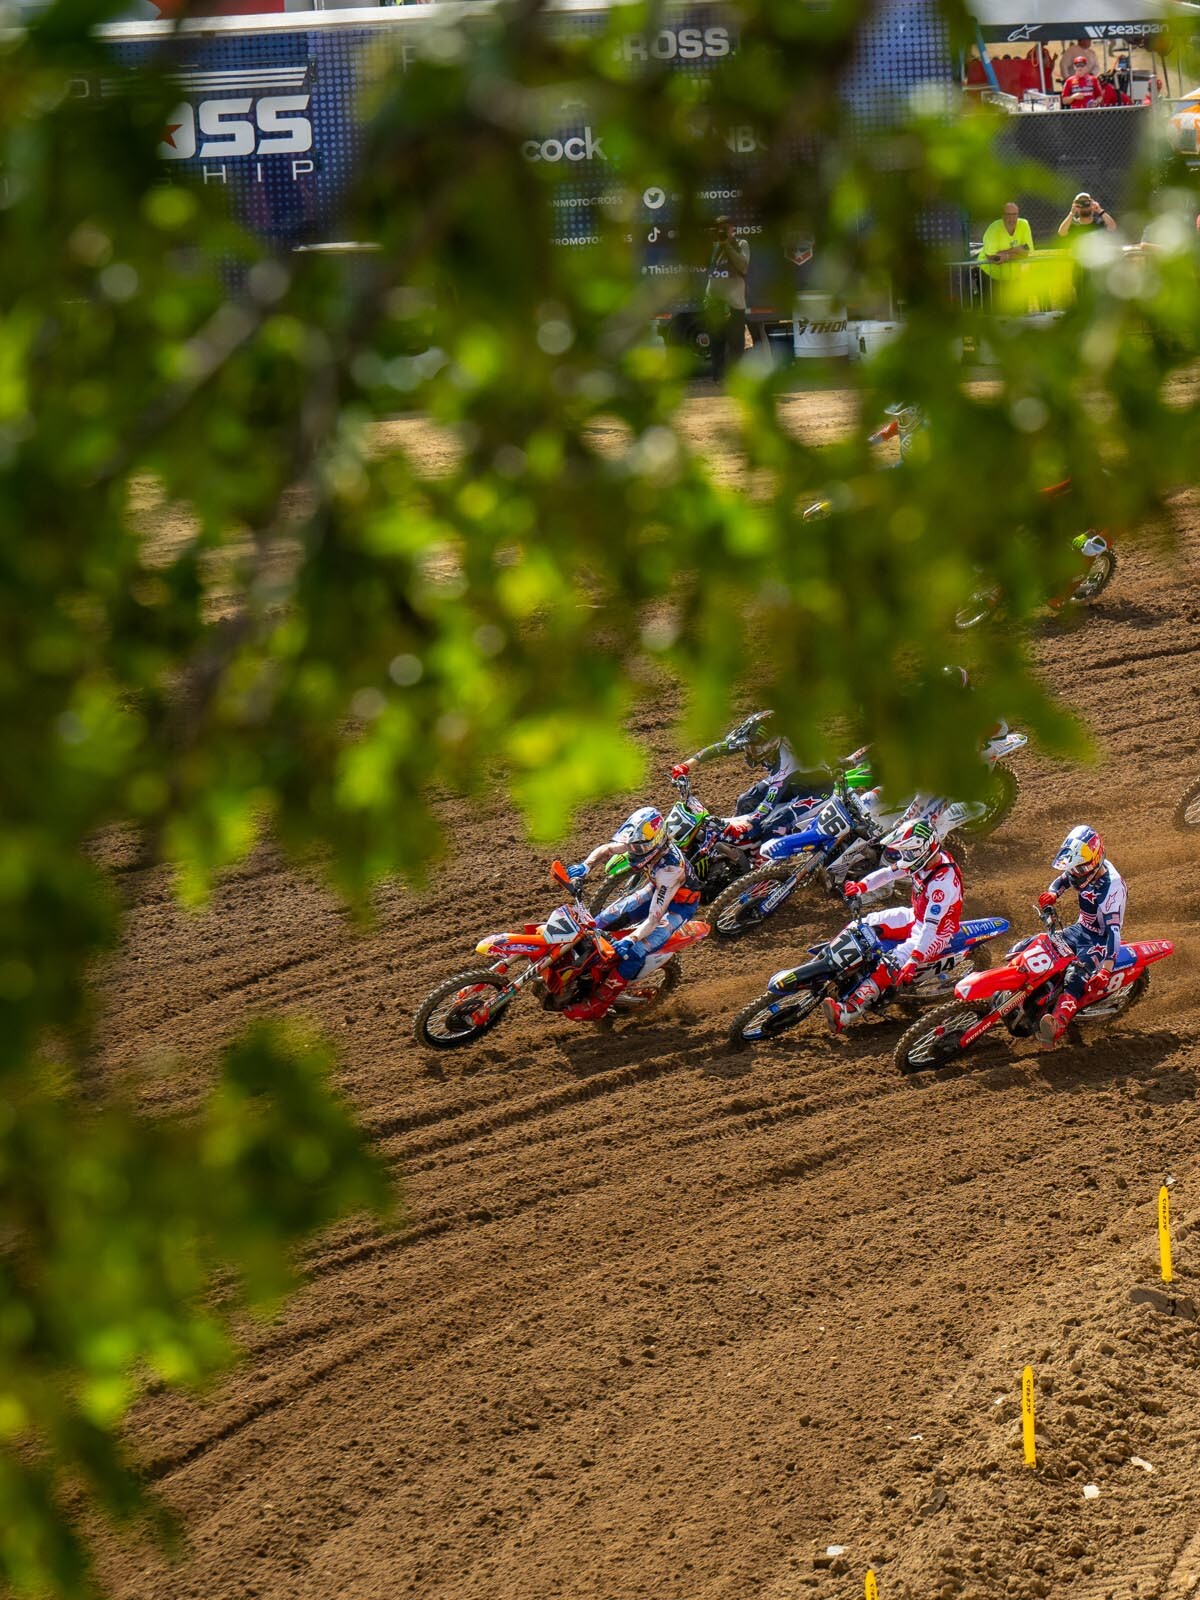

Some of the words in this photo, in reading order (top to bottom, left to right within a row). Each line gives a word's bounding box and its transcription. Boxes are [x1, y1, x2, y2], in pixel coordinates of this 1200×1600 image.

[819, 804, 847, 837] 36
[656, 885, 668, 906] THOR
[766, 884, 789, 908] DUNLOP
[832, 932, 863, 969] 14
[1022, 943, 1054, 974] 18
[965, 1021, 993, 1044] DUNLOP
